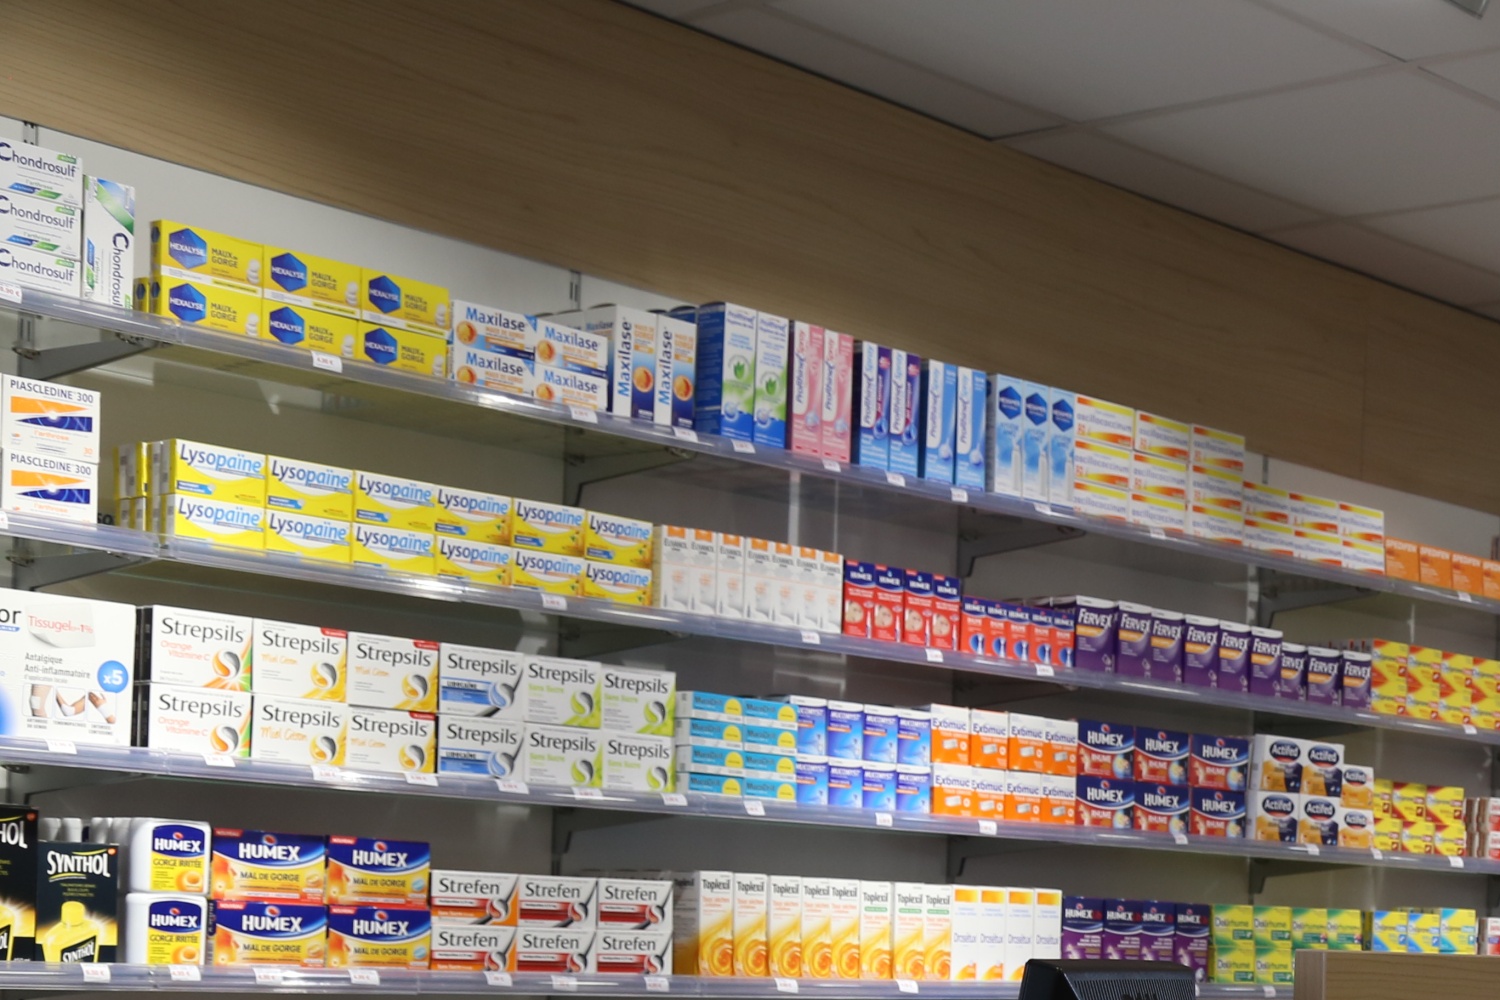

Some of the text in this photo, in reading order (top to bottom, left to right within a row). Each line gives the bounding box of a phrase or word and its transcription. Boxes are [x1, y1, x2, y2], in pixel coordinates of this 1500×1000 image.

[0, 142, 76, 178] Chondrosulf
[0, 195, 74, 230] Chondrosulf
[169, 240, 207, 256] HEXALYSE
[212, 248, 232, 259] MAUX
[112, 232, 129, 307] Chondrosul
[212, 258, 238, 269] GORGE
[271, 265, 306, 281] HEXALYSE
[312, 271, 332, 281] MAUX
[312, 280, 337, 292] GORGE
[369, 286, 402, 301] HEXALYSE
[466, 306, 525, 332] Maxilase
[544, 326, 598, 351] Maxilase
[466, 351, 524, 376] Maxilase
[544, 369, 598, 394] Maxilase
[10, 379, 93, 403] PIASCLEDINE 300
[10, 453, 91, 475] PIASCLEDINE 300
[180, 443, 262, 473] Lysopaïne
[271, 460, 350, 491] Lysopaïne
[359, 474, 432, 502] Lysopaïne
[179, 497, 262, 526] Lysopaïne
[269, 512, 347, 542] Lysopaïne
[356, 526, 432, 554] Lysopaïne
[28, 615, 71, 632] Tissugel
[1078, 607, 1114, 629] FERVEX
[1120, 612, 1151, 633] FERVEX
[161, 616, 245, 643] Strepsils
[1152, 619, 1182, 638] FERVEX
[161, 639, 193, 651] Orange
[262, 629, 340, 655] Strepsils
[25, 652, 63, 664] Antalgique
[168, 650, 201, 660] Vitamine
[356, 643, 432, 667] Strepsils
[25, 664, 91, 679] Anti-inflammatoire
[447, 653, 517, 676] Strepsils
[103, 669, 123, 685] x5
[529, 662, 595, 685] Strepsils
[159, 693, 243, 718] Strepsils
[158, 717, 190, 727] Orange
[262, 704, 340, 729] Strepsils
[166, 726, 199, 737] Vitamine
[352, 714, 428, 738] Strepsils
[1087, 731, 1124, 747] HUMEX
[1145, 737, 1179, 753] HUMEX
[1271, 743, 1299, 757] Actifed
[1310, 748, 1337, 761] Actifed
[1264, 798, 1292, 811] Actifed
[154, 837, 201, 853] HUMEX
[238, 843, 301, 861] HUMEX
[47, 850, 111, 878] SYNTHOL
[153, 858, 201, 868] GORGE IRRITÉE
[352, 850, 408, 867] HUMEX
[240, 871, 258, 879] MAL
[271, 873, 299, 882] GORGE
[353, 878, 369, 886] MAL
[381, 879, 406, 888] GORGE
[702, 879, 731, 891] Toplexil
[438, 878, 500, 896] Strefen
[526, 882, 581, 899] Strefen
[605, 886, 658, 902] Strefen
[737, 881, 765, 893] Toplexil
[772, 884, 799, 896] Toplexil
[151, 913, 197, 928] HUMEX
[242, 915, 303, 932] HUMEX
[352, 919, 409, 936] HUMEX
[150, 934, 198, 944] GORGE IRRITÉE
[438, 930, 498, 949] Strefen
[523, 934, 580, 950] Strefen
[603, 937, 656, 952] Strefen
[243, 943, 260, 952] MAL
[273, 944, 301, 953] GORGE
[382, 948, 408, 956] GORGE
